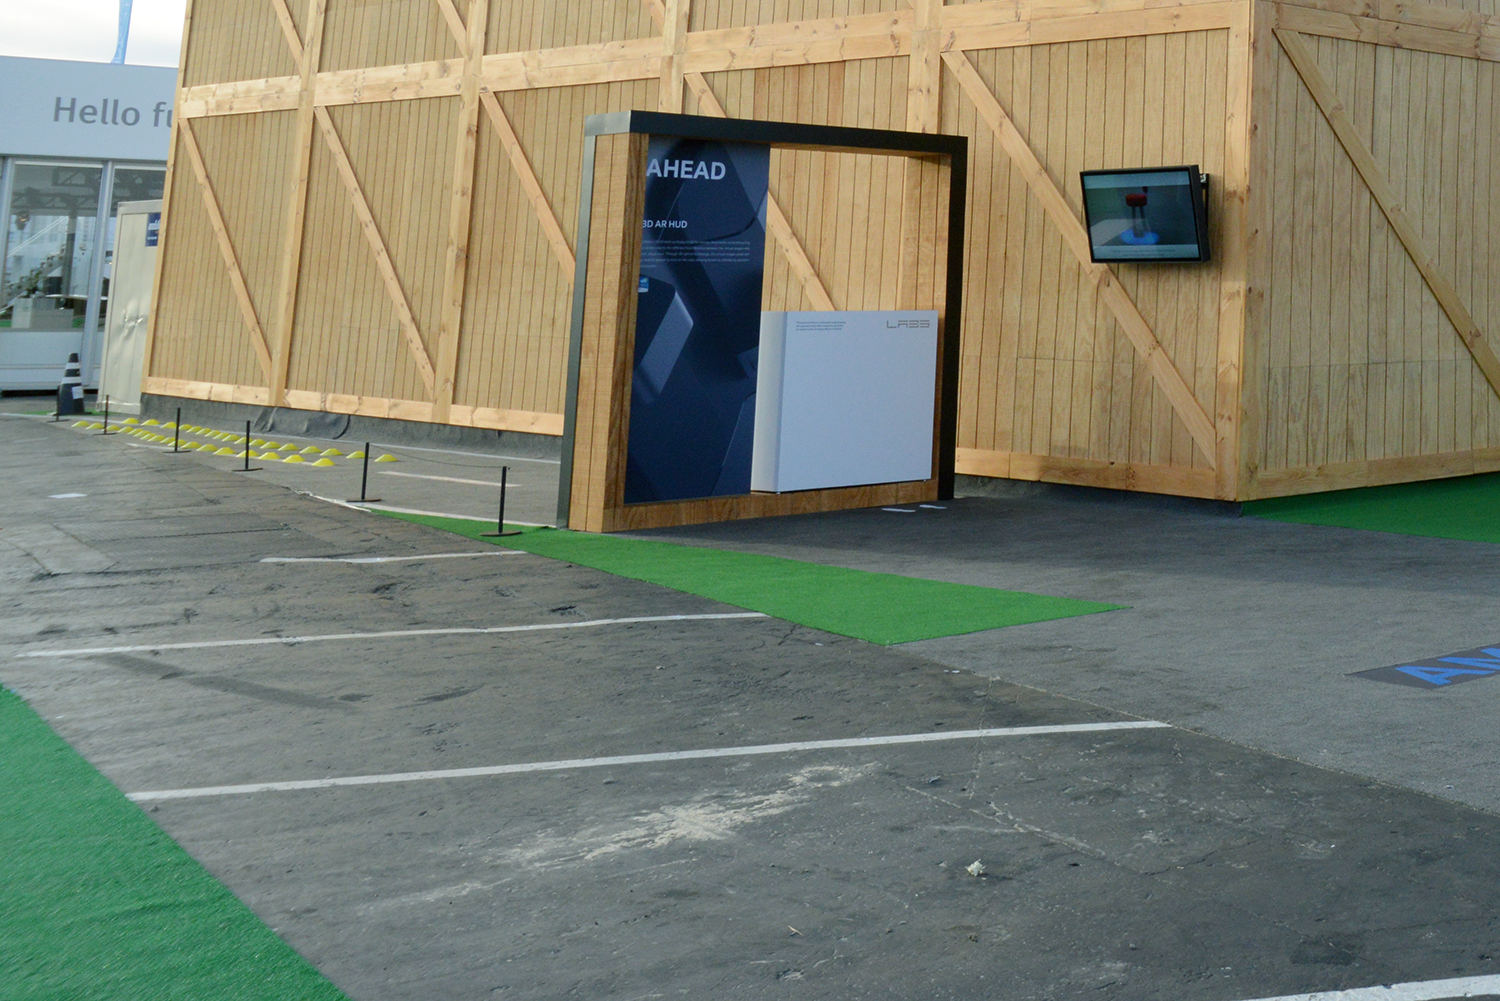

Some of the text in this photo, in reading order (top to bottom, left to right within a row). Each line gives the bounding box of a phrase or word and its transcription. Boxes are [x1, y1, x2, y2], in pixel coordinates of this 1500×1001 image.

[53, 96, 140, 127] Hello
[646, 158, 727, 180] AHEAD
[655, 219, 667, 228] AR
[668, 219, 688, 229] HUD
[887, 319, 930, 329] LABS
